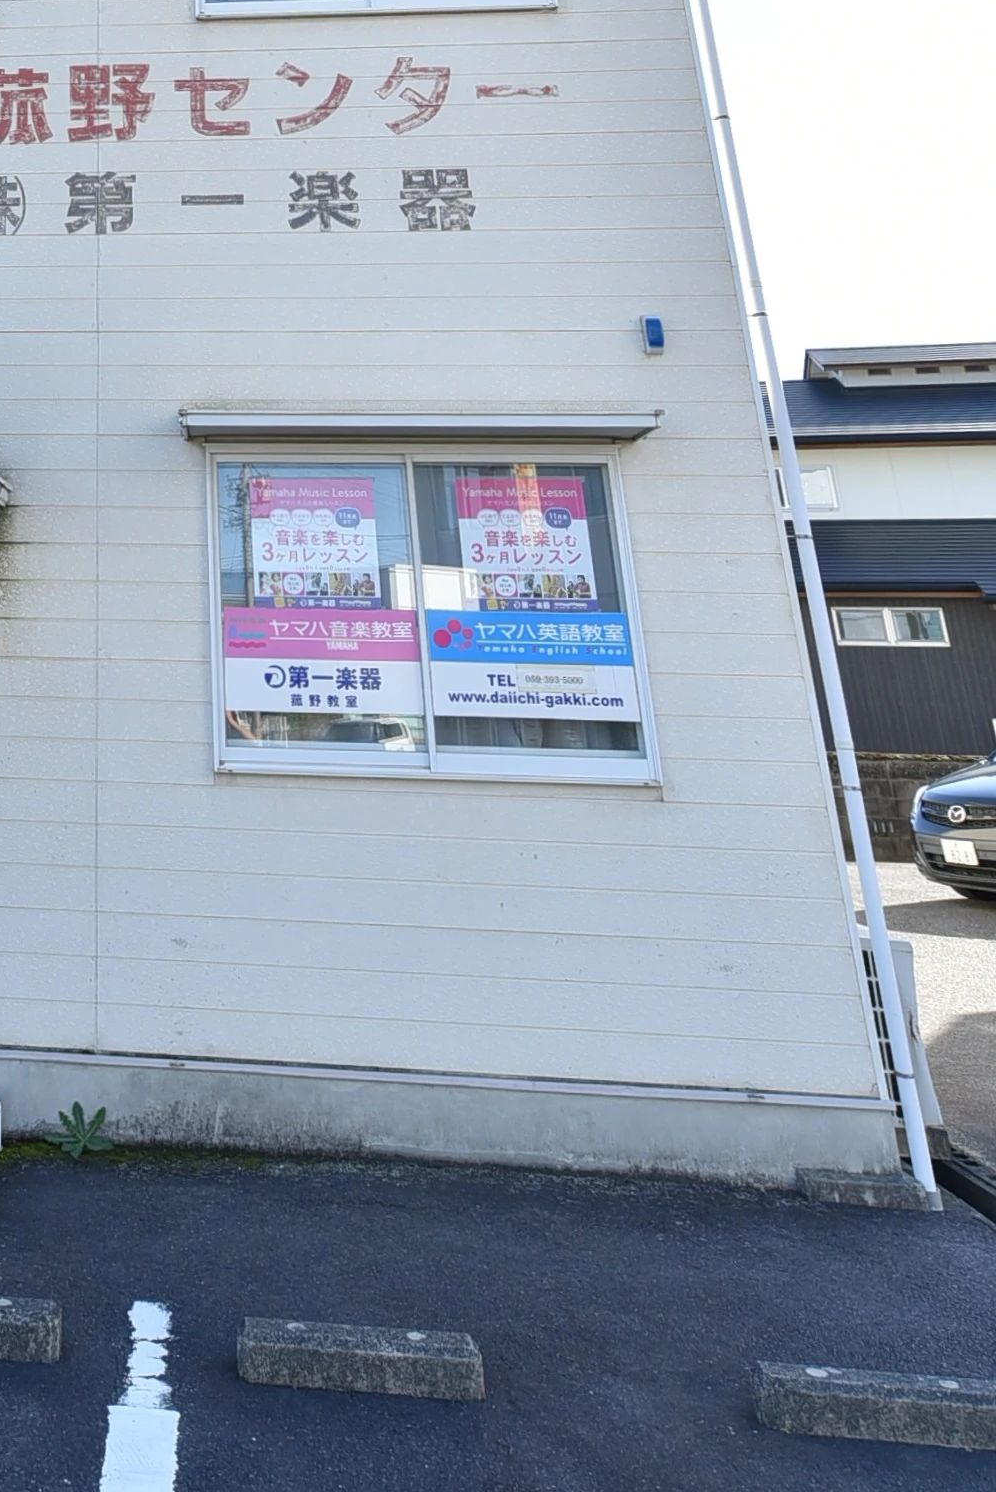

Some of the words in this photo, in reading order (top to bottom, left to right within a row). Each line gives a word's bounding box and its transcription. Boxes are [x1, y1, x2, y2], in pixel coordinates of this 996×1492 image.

[298, 487, 330, 498] Music
[332, 487, 368, 498] Lesson
[462, 487, 503, 498] Yamaha
[506, 487, 539, 498] Music
[541, 487, 578, 499] Lesson
[275, 528, 365, 547] 音楽を楽しむ
[484, 530, 577, 548] 音楽を楽しむ
[269, 619, 414, 639] ヤマハ音楽教室
[474, 622, 626, 643] ヤマハ英語教室
[325, 640, 360, 651] YAMAHA
[288, 665, 382, 691] 第一楽器
[487, 674, 516, 687] TEL
[290, 693, 359, 708] 菰野教室
[448, 691, 625, 708] www.daiichi-gakki.com
